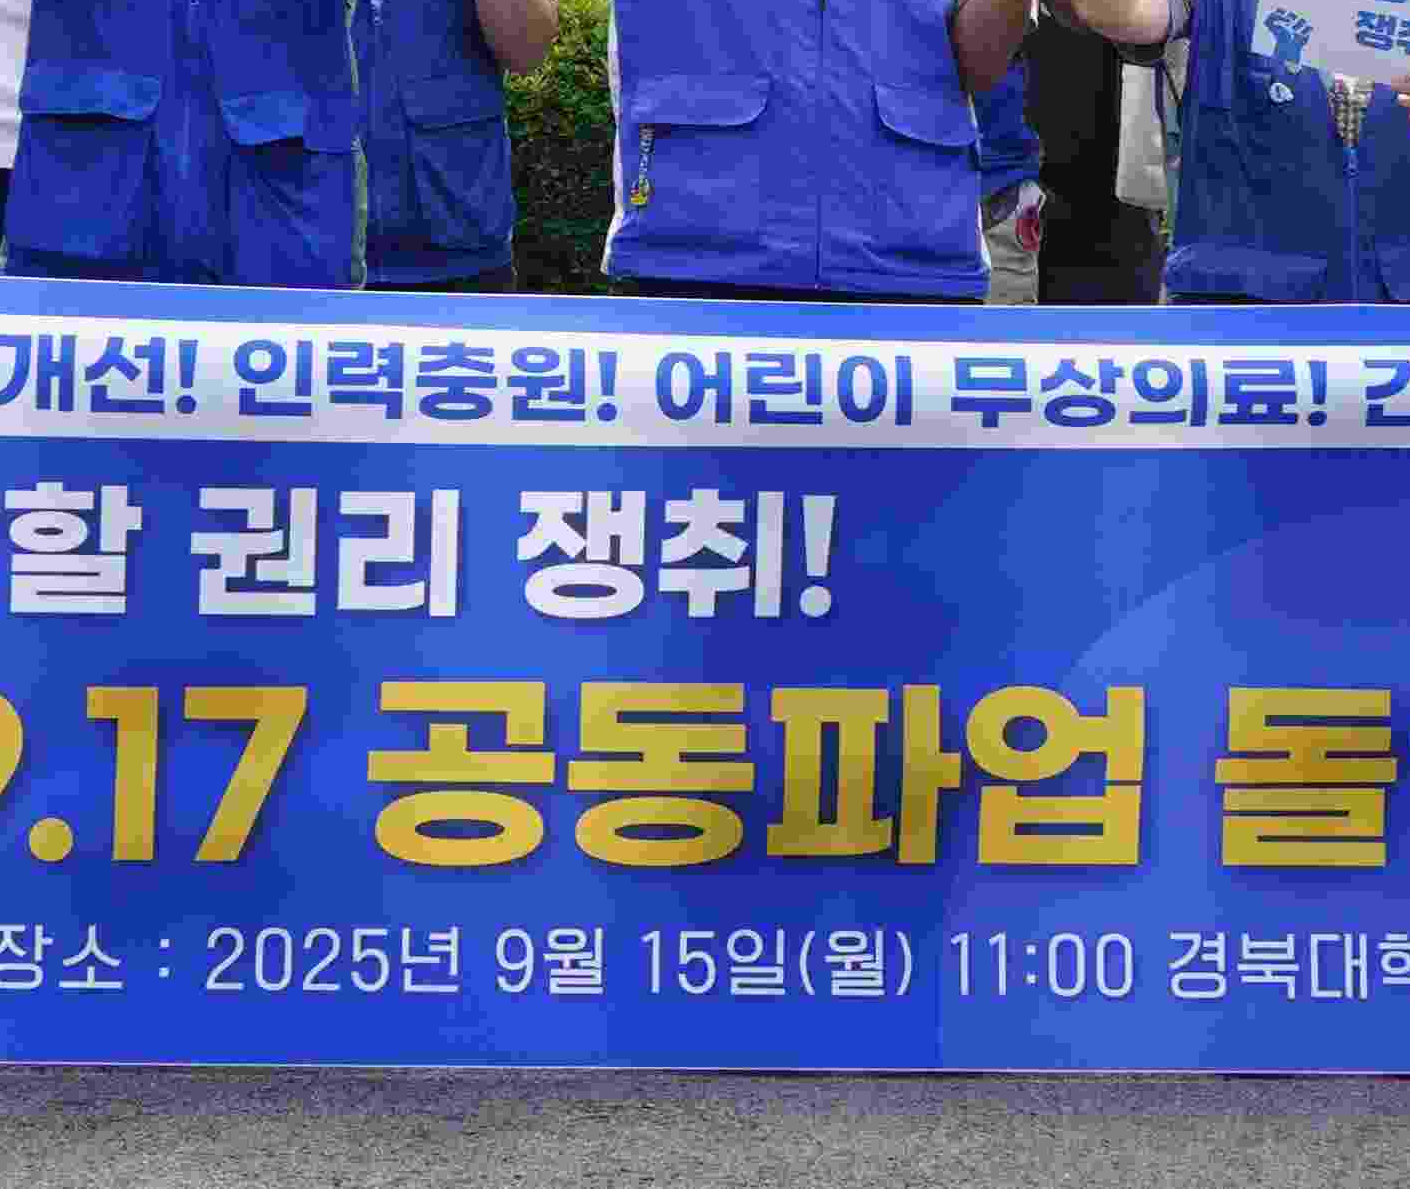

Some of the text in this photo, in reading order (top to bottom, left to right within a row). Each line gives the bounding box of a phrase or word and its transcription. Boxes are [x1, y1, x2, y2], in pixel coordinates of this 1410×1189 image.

[234, 338, 618, 422] 인력충원!
[655, 351, 914, 429] 어린이
[950, 355, 1328, 431] 무상의료!
[190, 486, 459, 618] 권리
[517, 488, 838, 620] 쟁취!
[367, 680, 1145, 868] 공동파업
[204, 925, 460, 994] 2025년
[496, 925, 605, 996] 9월
[640, 929, 913, 998] 15일(월)
[949, 931, 1134, 998] 11:00
